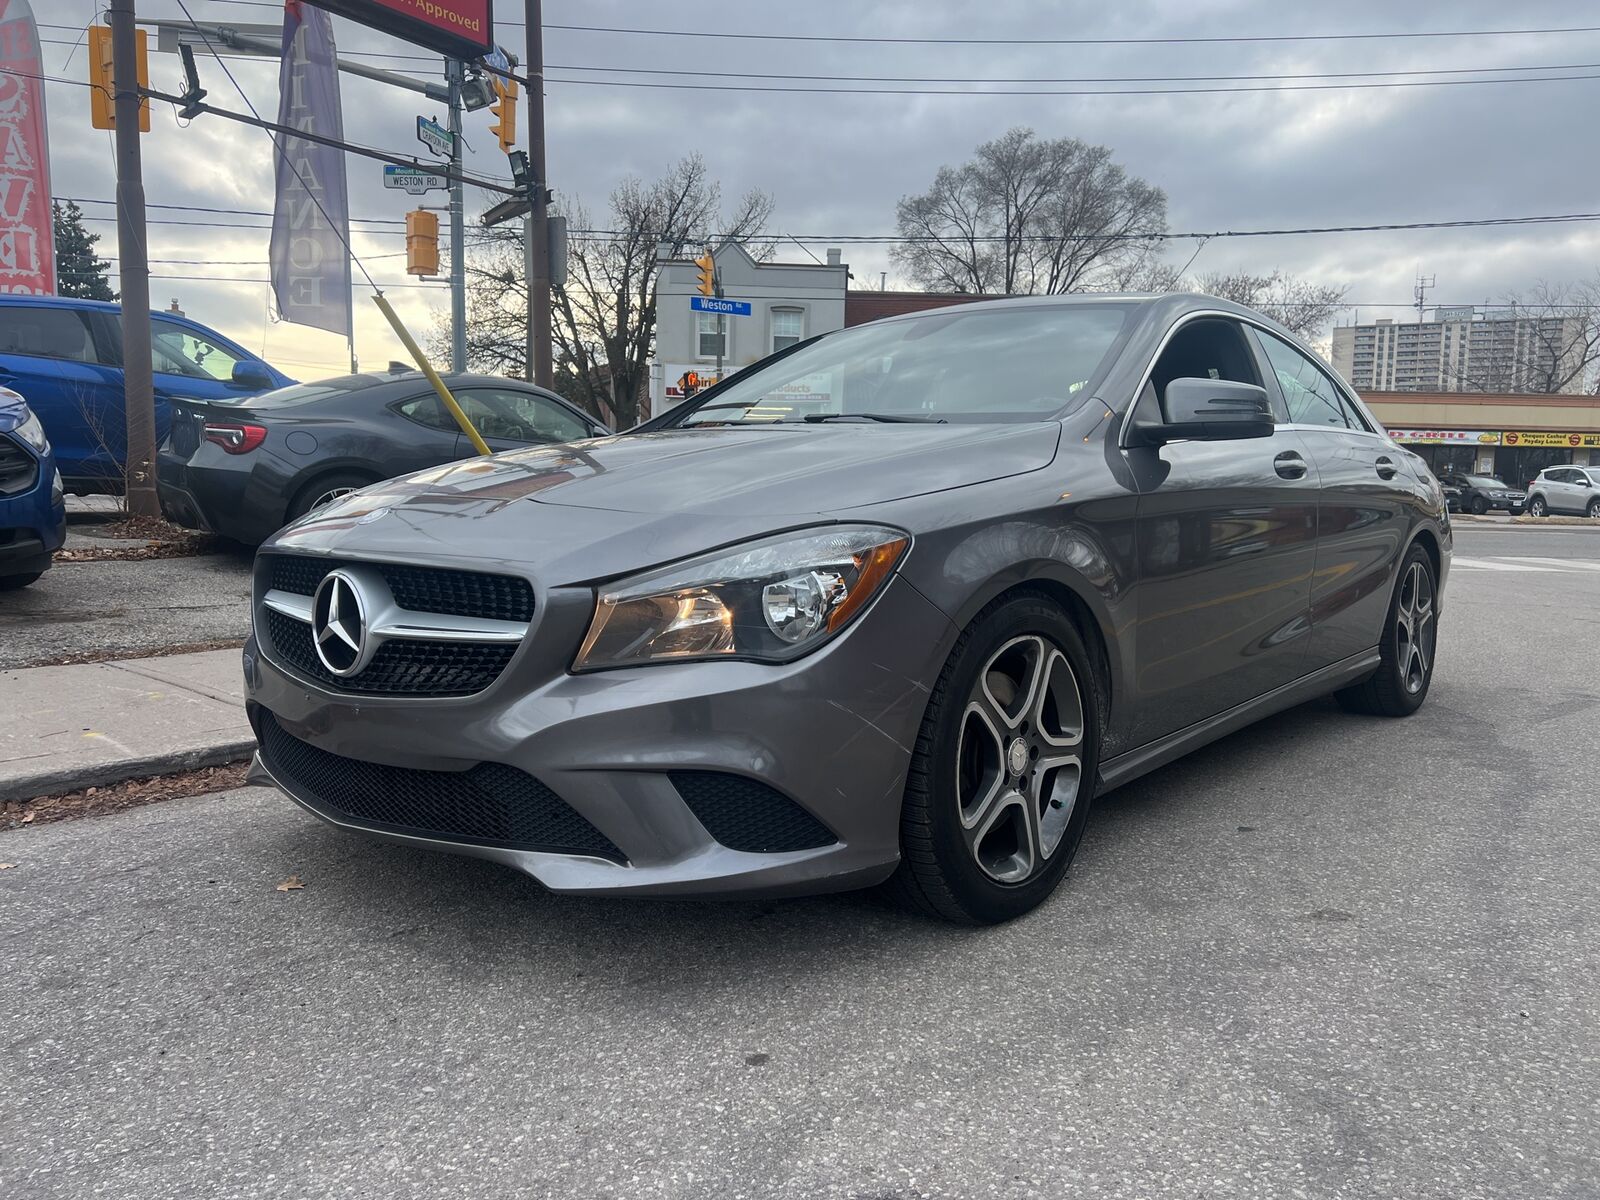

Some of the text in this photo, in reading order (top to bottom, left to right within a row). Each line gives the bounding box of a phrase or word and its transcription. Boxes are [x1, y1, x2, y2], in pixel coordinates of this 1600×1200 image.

[415, 0, 480, 32] Approved
[393, 176, 438, 186] WESTON RD
[700, 298, 732, 311] Weston
